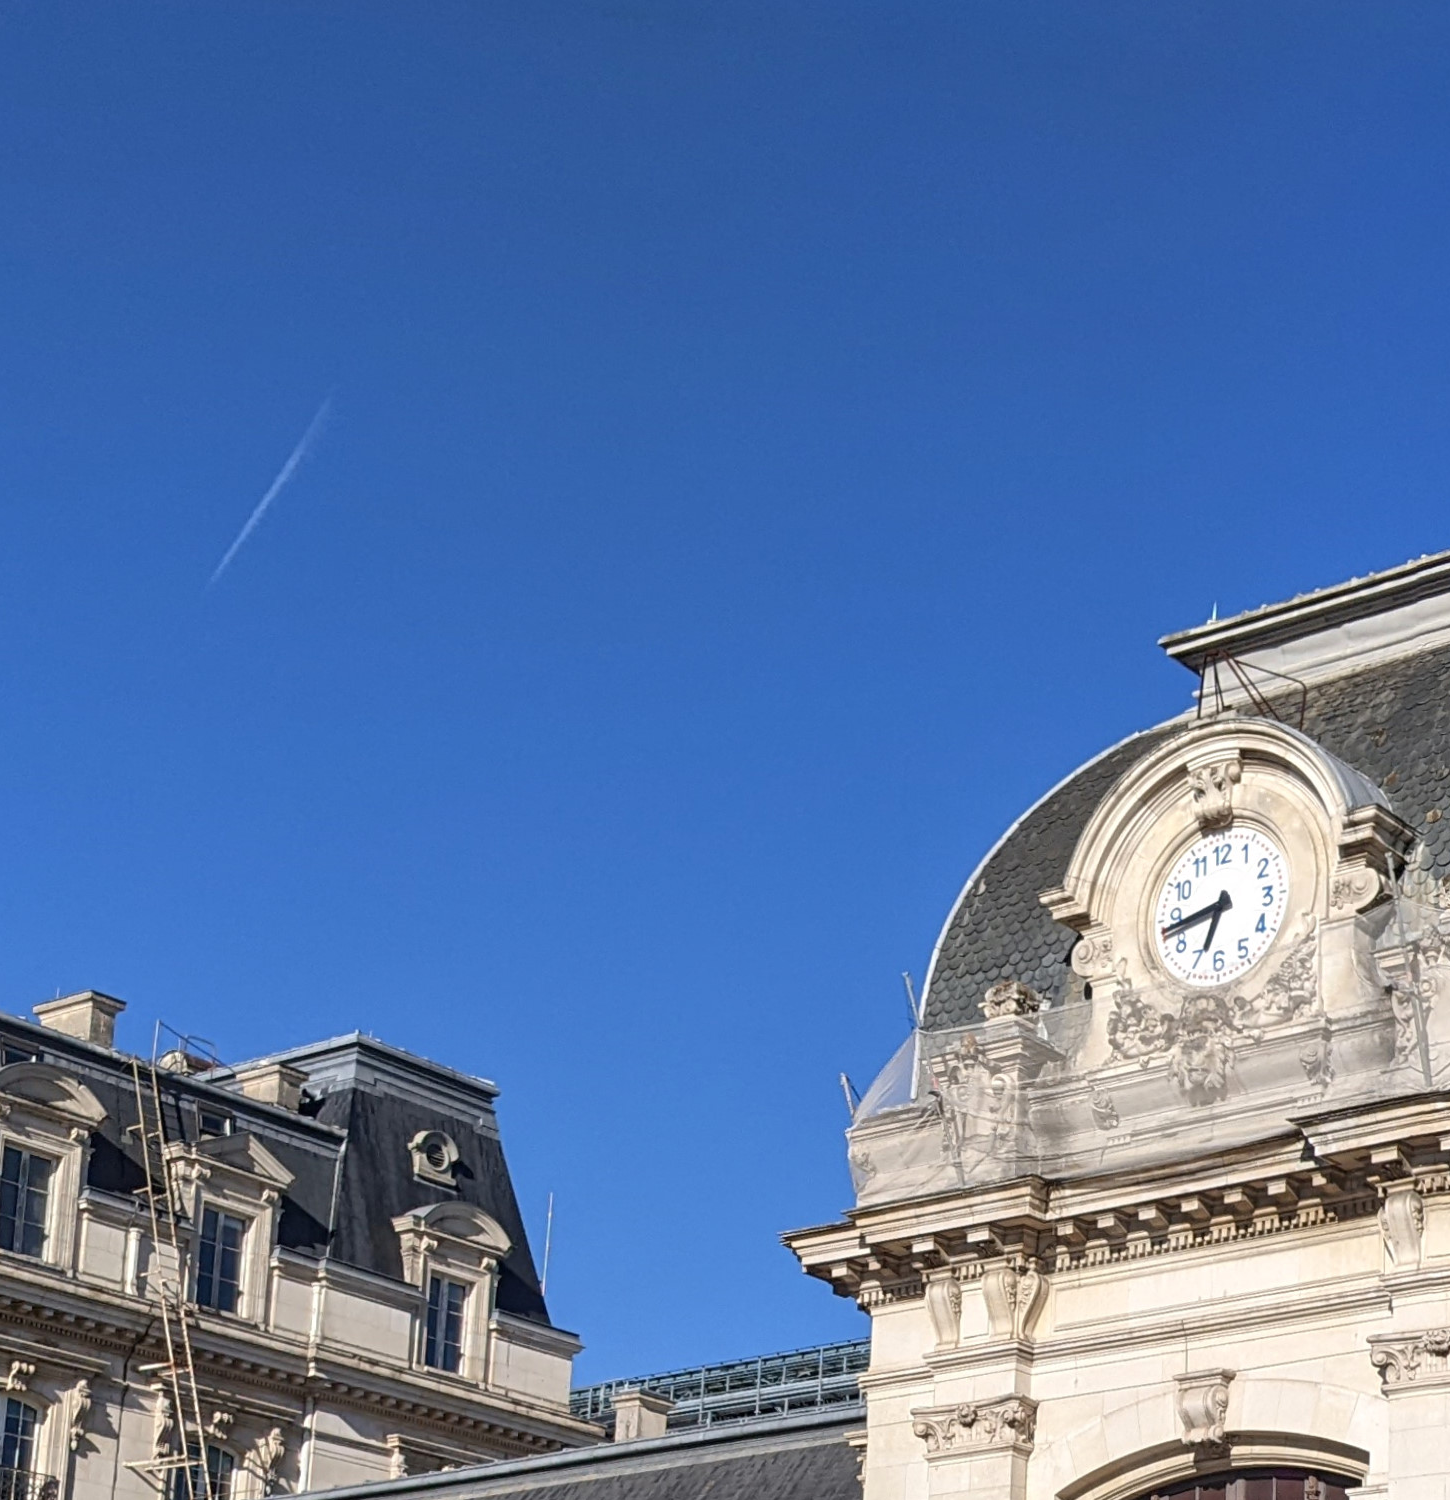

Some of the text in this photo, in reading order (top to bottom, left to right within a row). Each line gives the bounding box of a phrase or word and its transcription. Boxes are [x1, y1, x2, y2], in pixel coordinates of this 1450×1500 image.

[1212, 843, 1232, 866] 12
[1241, 843, 1249, 864] 1
[1192, 856, 1207, 878] 11
[1257, 858, 1269, 879] 2
[1175, 880, 1192, 901] 10
[1262, 885, 1274, 907] 3
[1170, 907, 1182, 926] 9
[1255, 913, 1266, 933] 4
[1176, 931, 1187, 953] 8
[1238, 937, 1249, 959] 5
[1192, 949, 1204, 969] 7
[1213, 950, 1225, 972] 6
